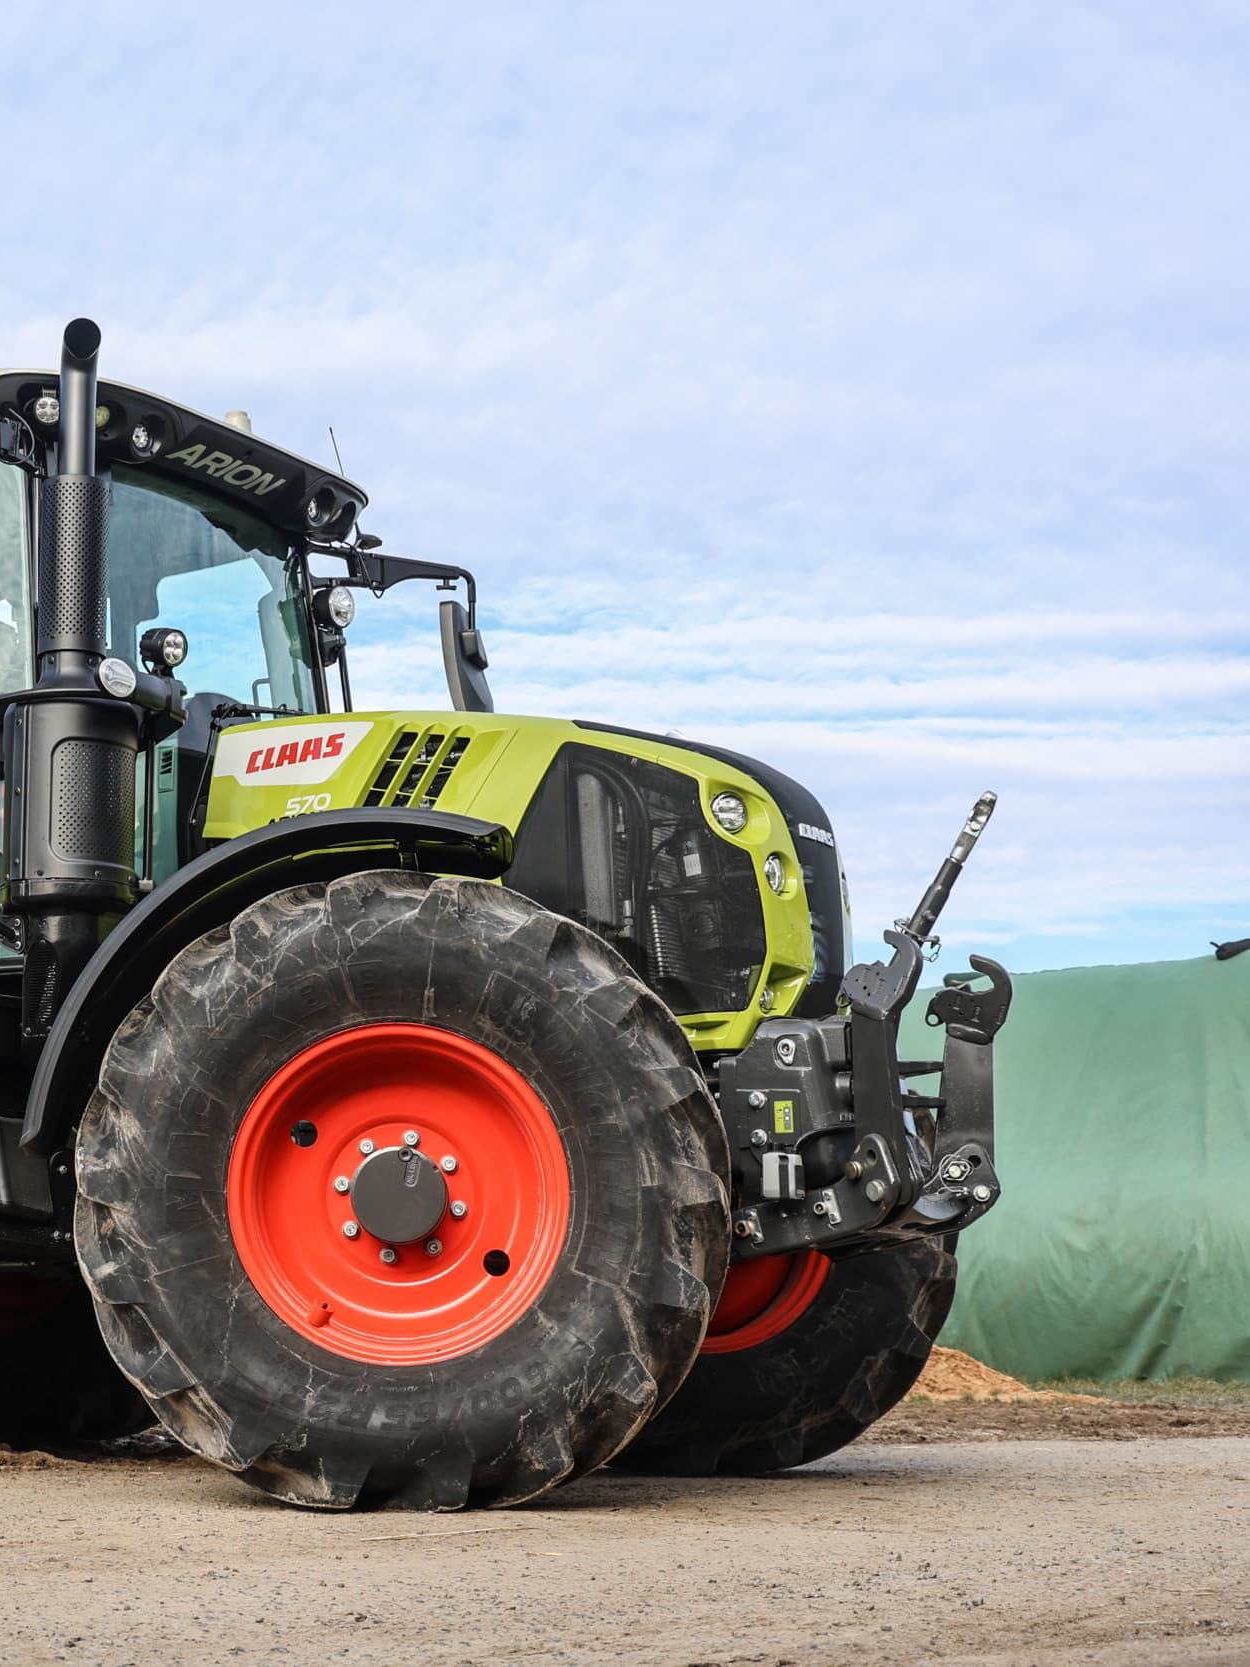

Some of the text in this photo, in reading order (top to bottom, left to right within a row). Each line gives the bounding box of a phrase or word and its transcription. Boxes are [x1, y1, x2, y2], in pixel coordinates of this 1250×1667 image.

[165, 443, 287, 496] ARION
[245, 733, 346, 774] CLAAS
[285, 792, 332, 816] 570
